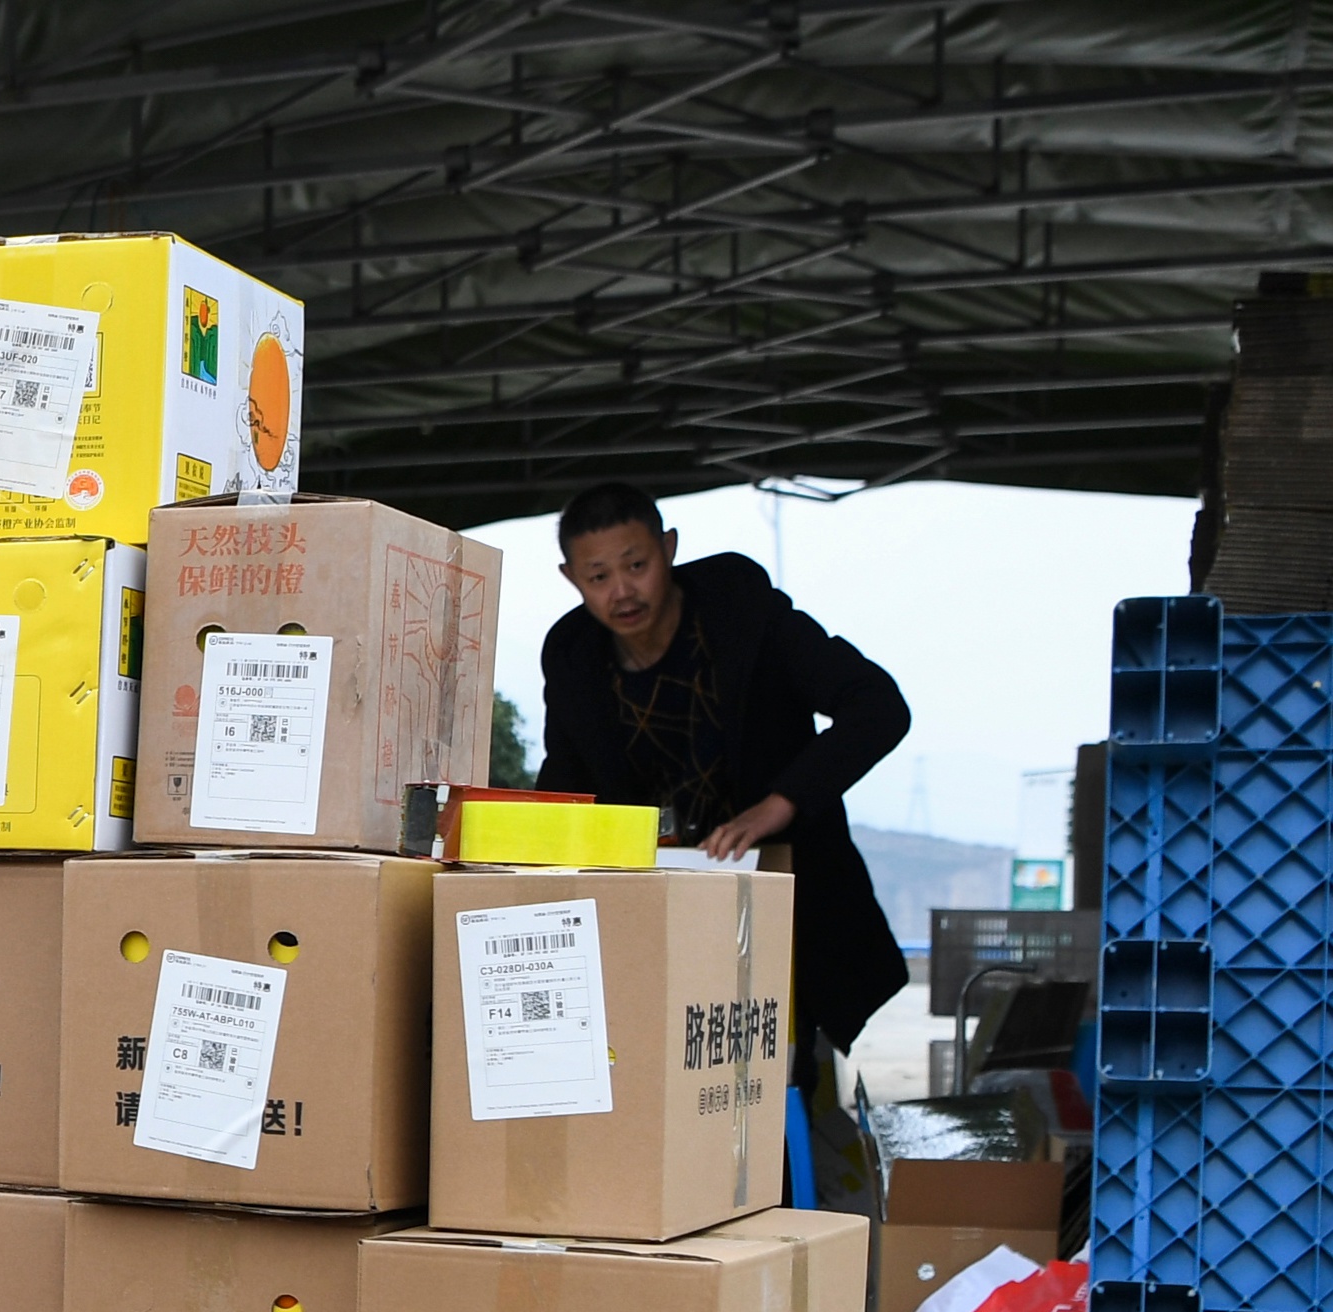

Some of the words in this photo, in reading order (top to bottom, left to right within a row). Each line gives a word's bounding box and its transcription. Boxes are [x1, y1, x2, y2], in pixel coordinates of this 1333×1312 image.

[179, 522, 306, 557] 天然枝头
[177, 563, 305, 597] 保鲜的橙
[218, 686, 263, 696] 516J-000
[488, 1007, 512, 1020] F14
[683, 997, 778, 1070] 脐橙保护箱
[172, 1048, 189, 1061] C8
